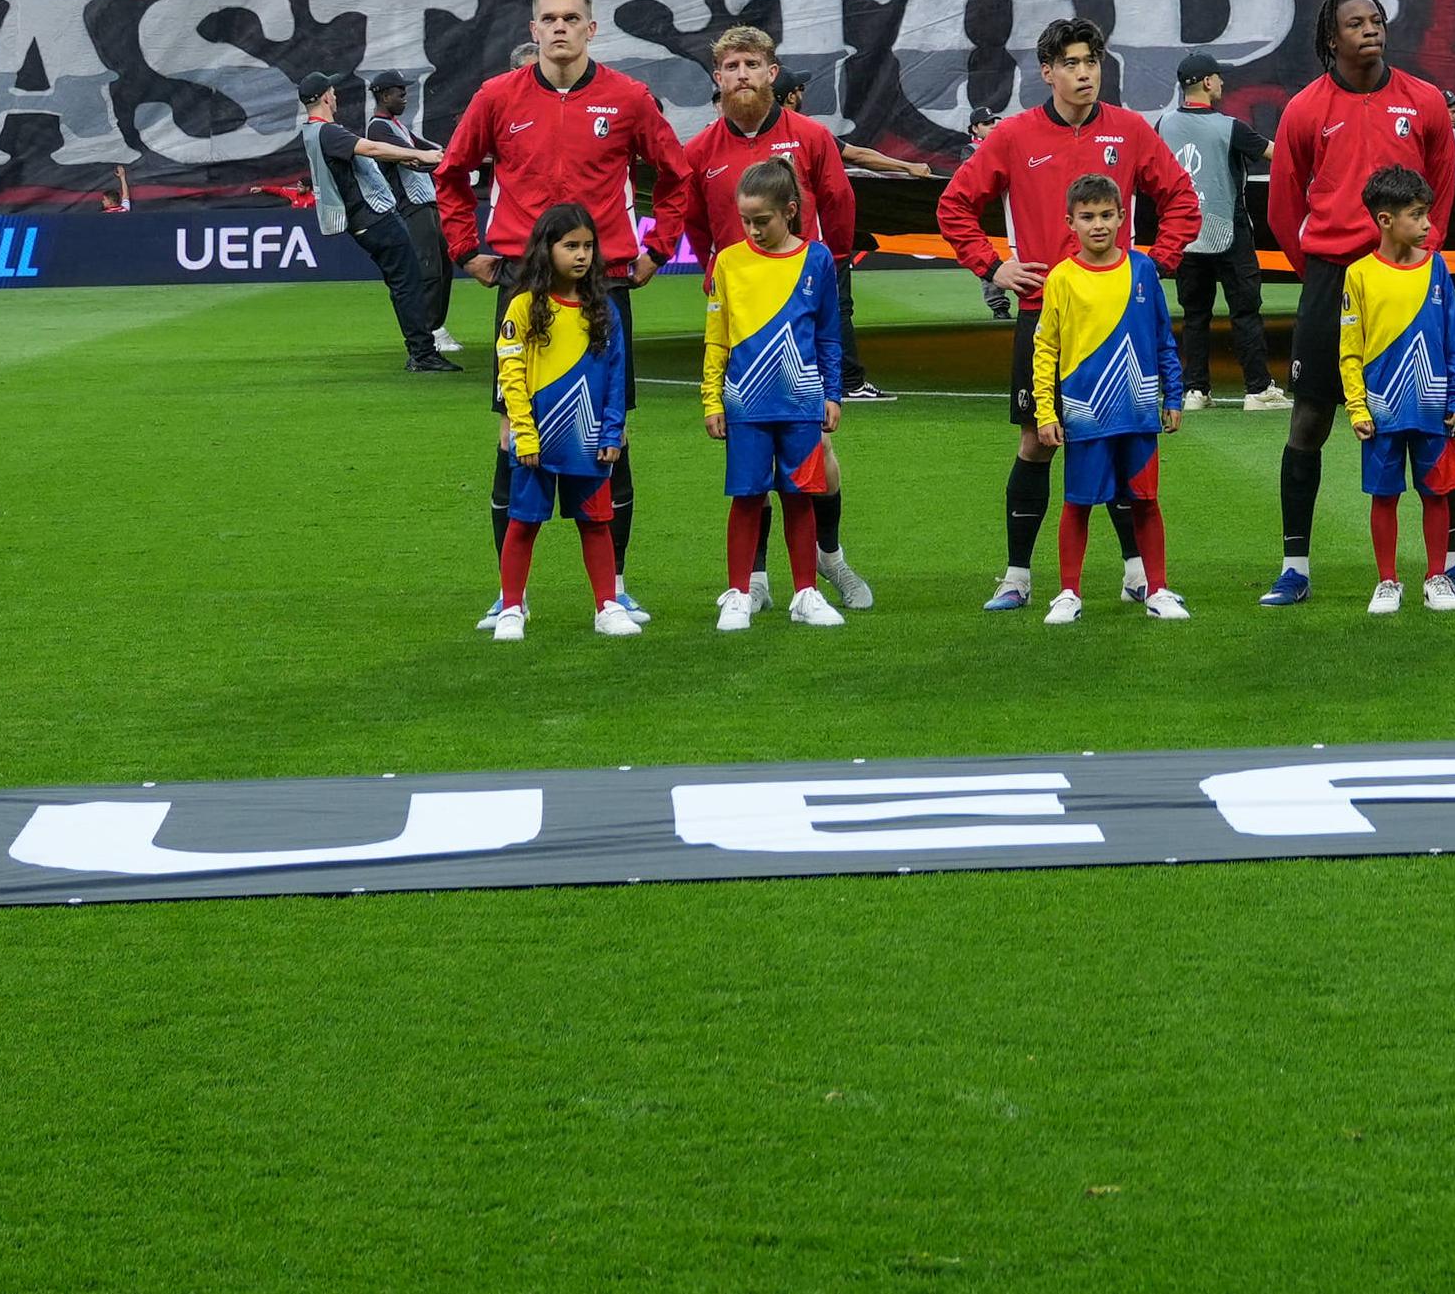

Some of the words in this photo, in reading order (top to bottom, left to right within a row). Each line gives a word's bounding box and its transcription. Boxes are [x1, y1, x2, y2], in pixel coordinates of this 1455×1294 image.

[586, 106, 618, 114] JOBRAD
[1387, 106, 1417, 116] JOBRAD
[1094, 135, 1124, 144] JOBRAD
[771, 141, 800, 150] JOBRAD
[176, 225, 318, 271] UEFA
